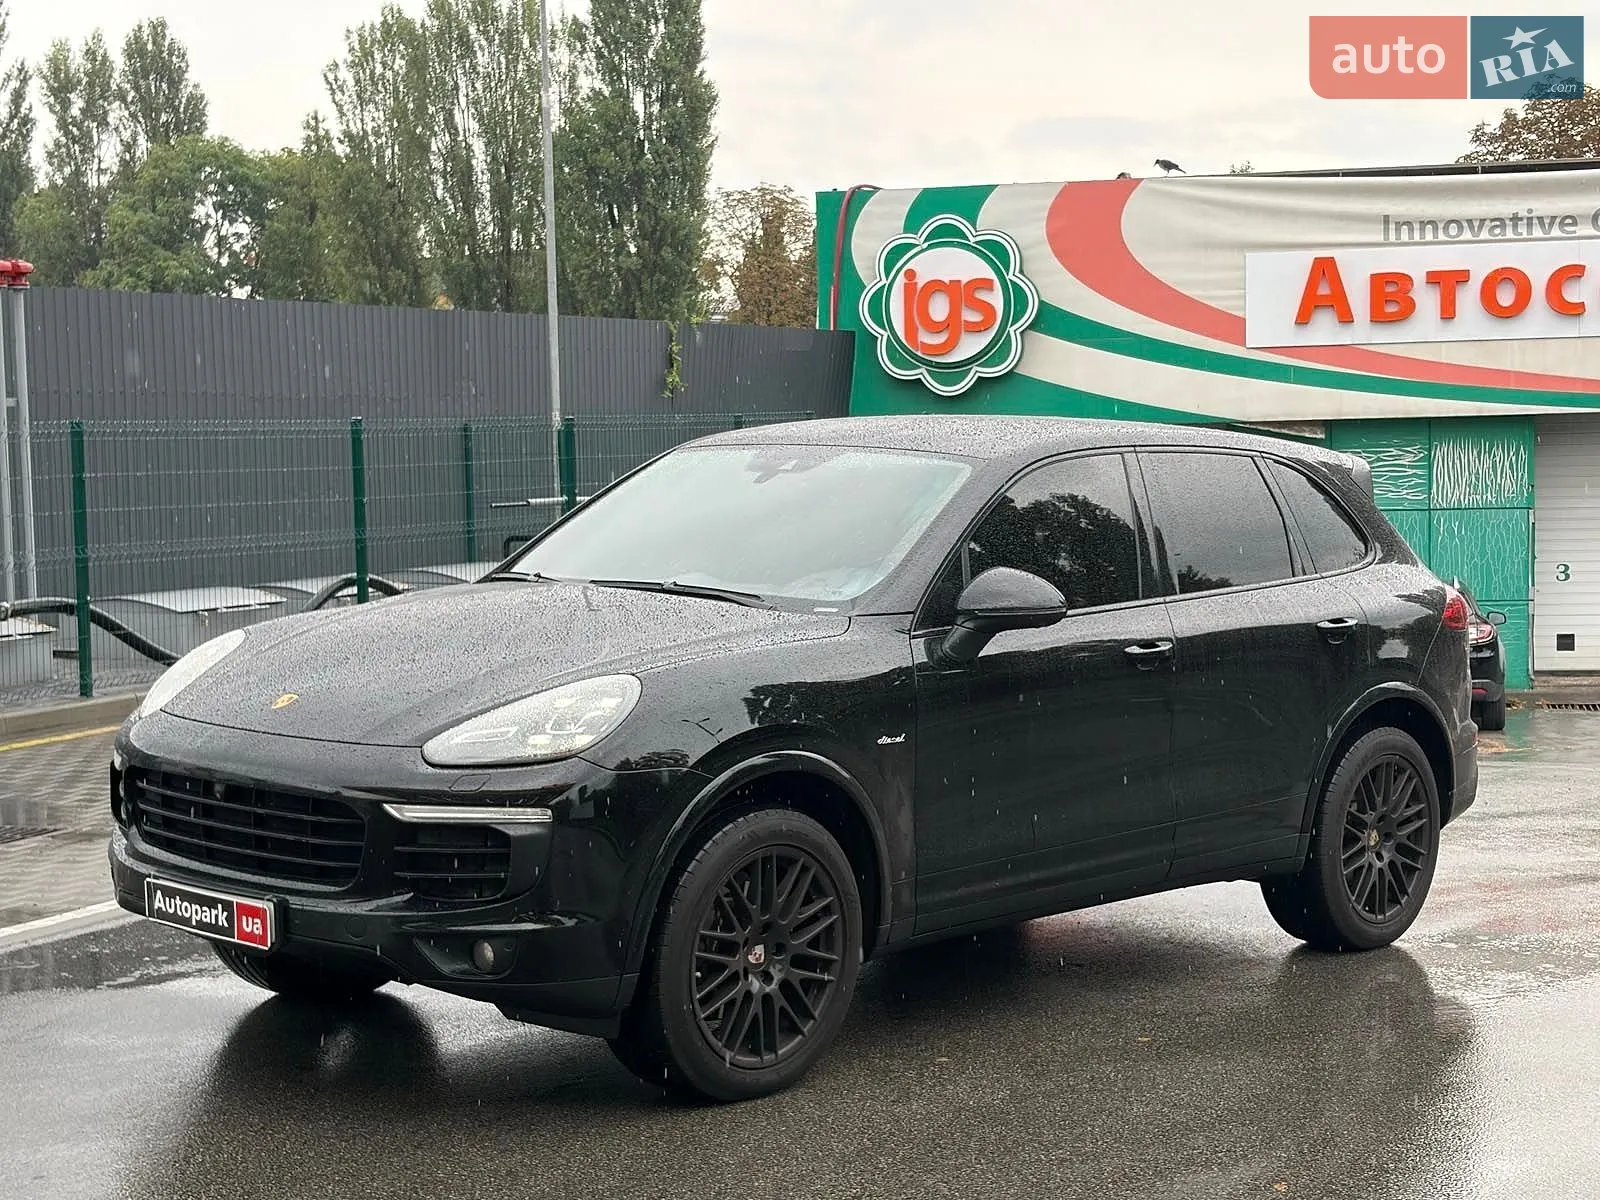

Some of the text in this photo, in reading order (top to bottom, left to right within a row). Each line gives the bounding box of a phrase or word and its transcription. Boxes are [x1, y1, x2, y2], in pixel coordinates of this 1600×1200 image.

[1382, 208, 1579, 241] Innovative
[903, 268, 997, 356] igs
[1555, 563, 1571, 582] 3
[154, 889, 263, 936] Autopark ua
